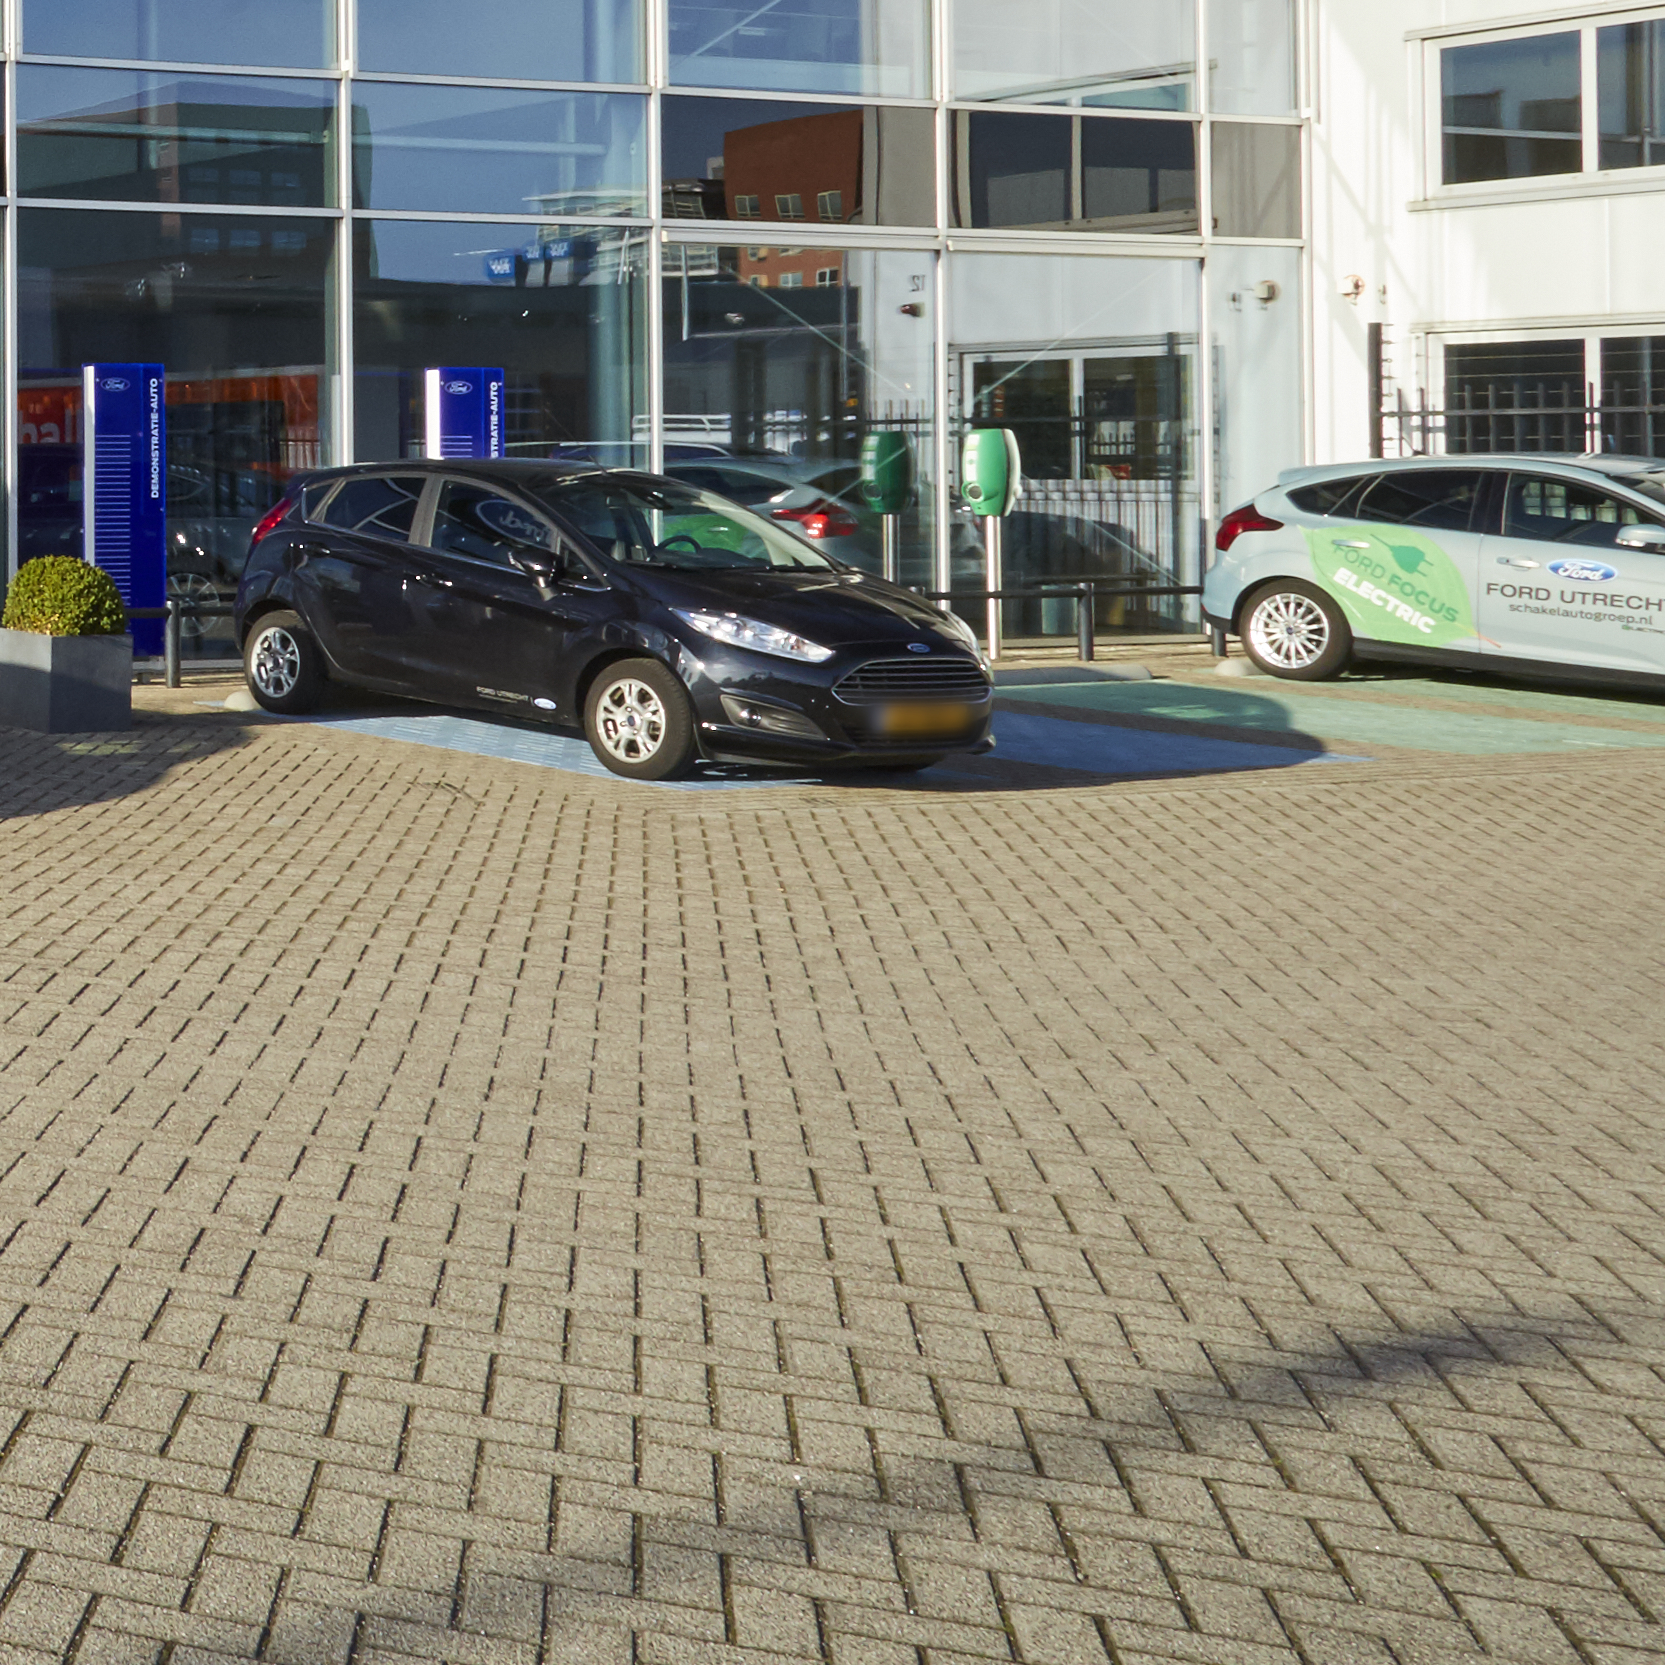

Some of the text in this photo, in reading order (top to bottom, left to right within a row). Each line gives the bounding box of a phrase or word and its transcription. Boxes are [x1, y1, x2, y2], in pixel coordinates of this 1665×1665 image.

[150, 378, 159, 499] DEMONSTRATIE-AUTO
[1557, 560, 1604, 582] Ford
[1333, 567, 1436, 634] ELECTRIC
[1387, 573, 1459, 623] FOCUS
[1486, 582, 1665, 612] FORD UTRECH
[1509, 603, 1653, 626] schakelautogroep.nl
